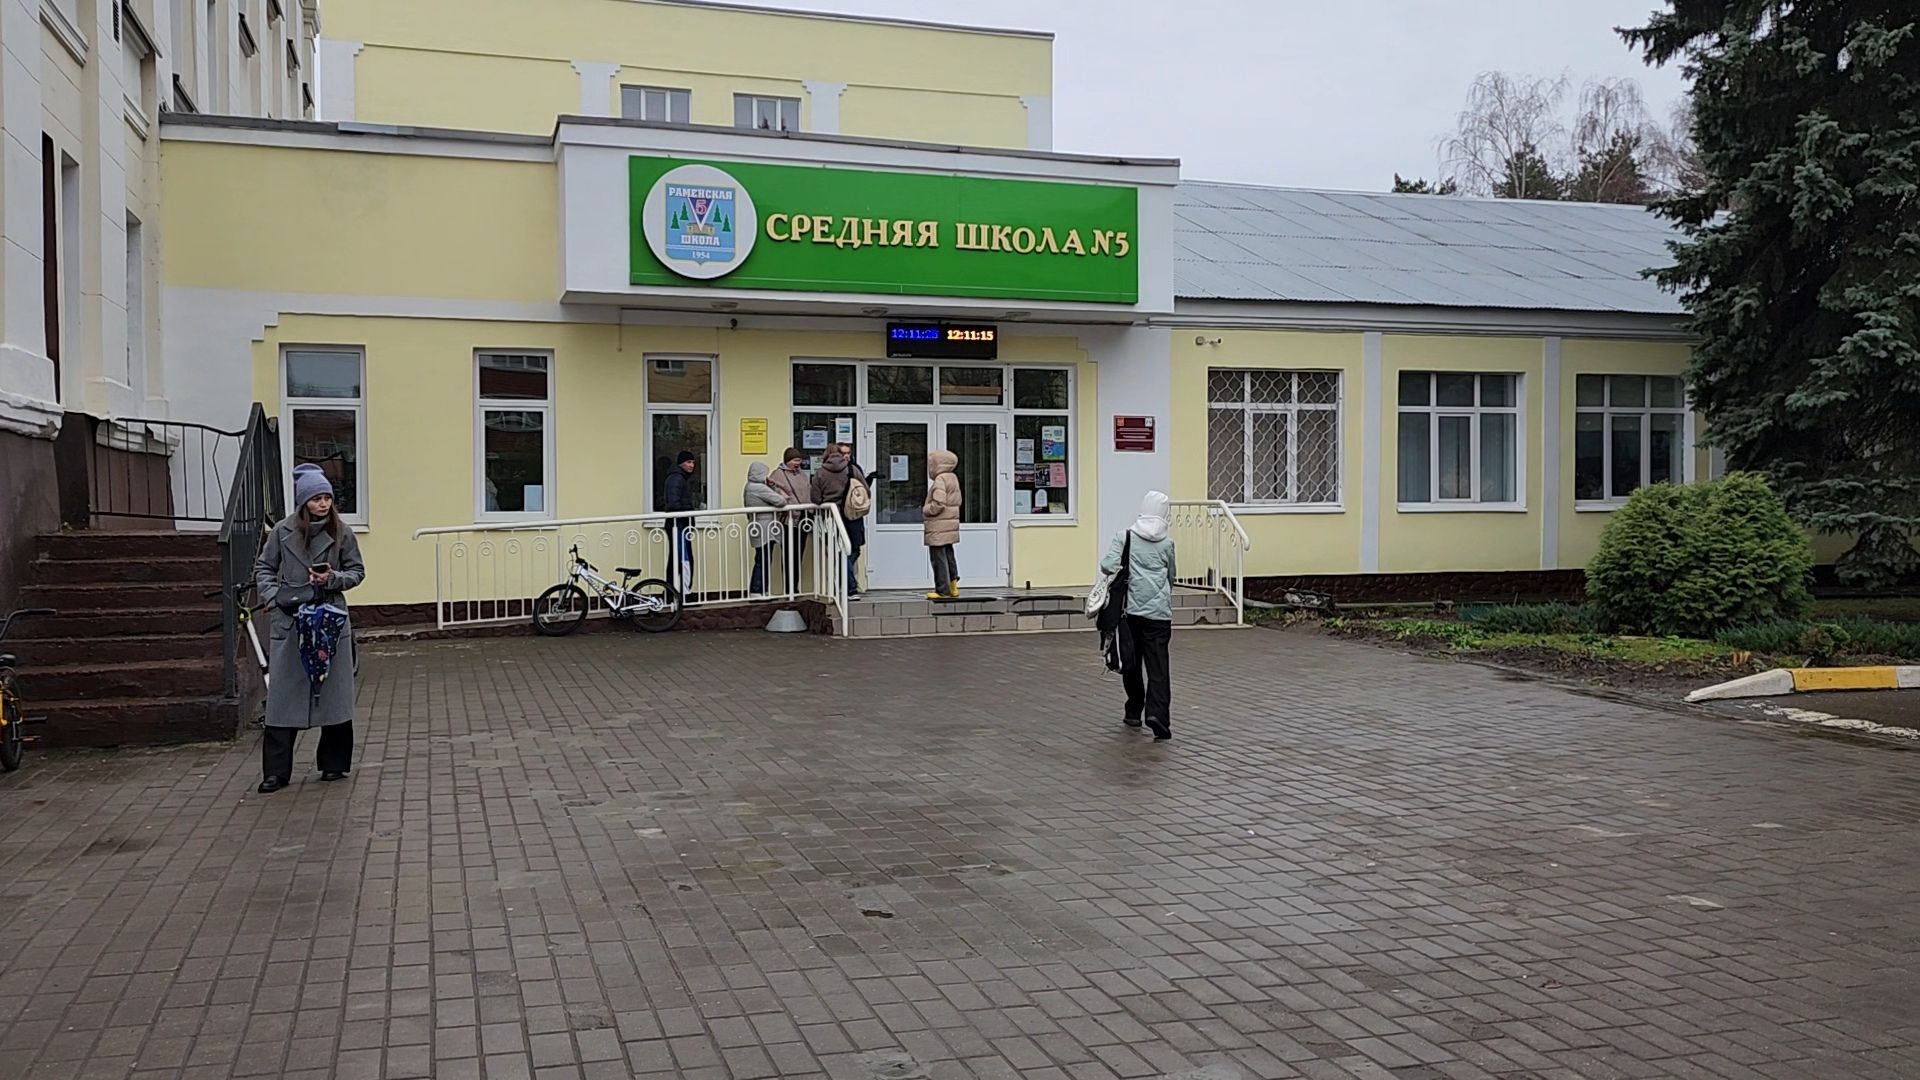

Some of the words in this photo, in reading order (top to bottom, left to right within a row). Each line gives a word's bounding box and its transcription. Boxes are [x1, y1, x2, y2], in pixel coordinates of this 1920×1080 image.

[668, 187, 733, 200] РАМЕНСКАЯ
[695, 199, 707, 215] 5
[681, 235, 720, 245] ШКОЛА
[766, 213, 939, 248] СРЕДНЯЯ
[955, 223, 1086, 255] ШКОЛА
[692, 251, 710, 259] 1954
[947, 329, 994, 340] 12:11:15
